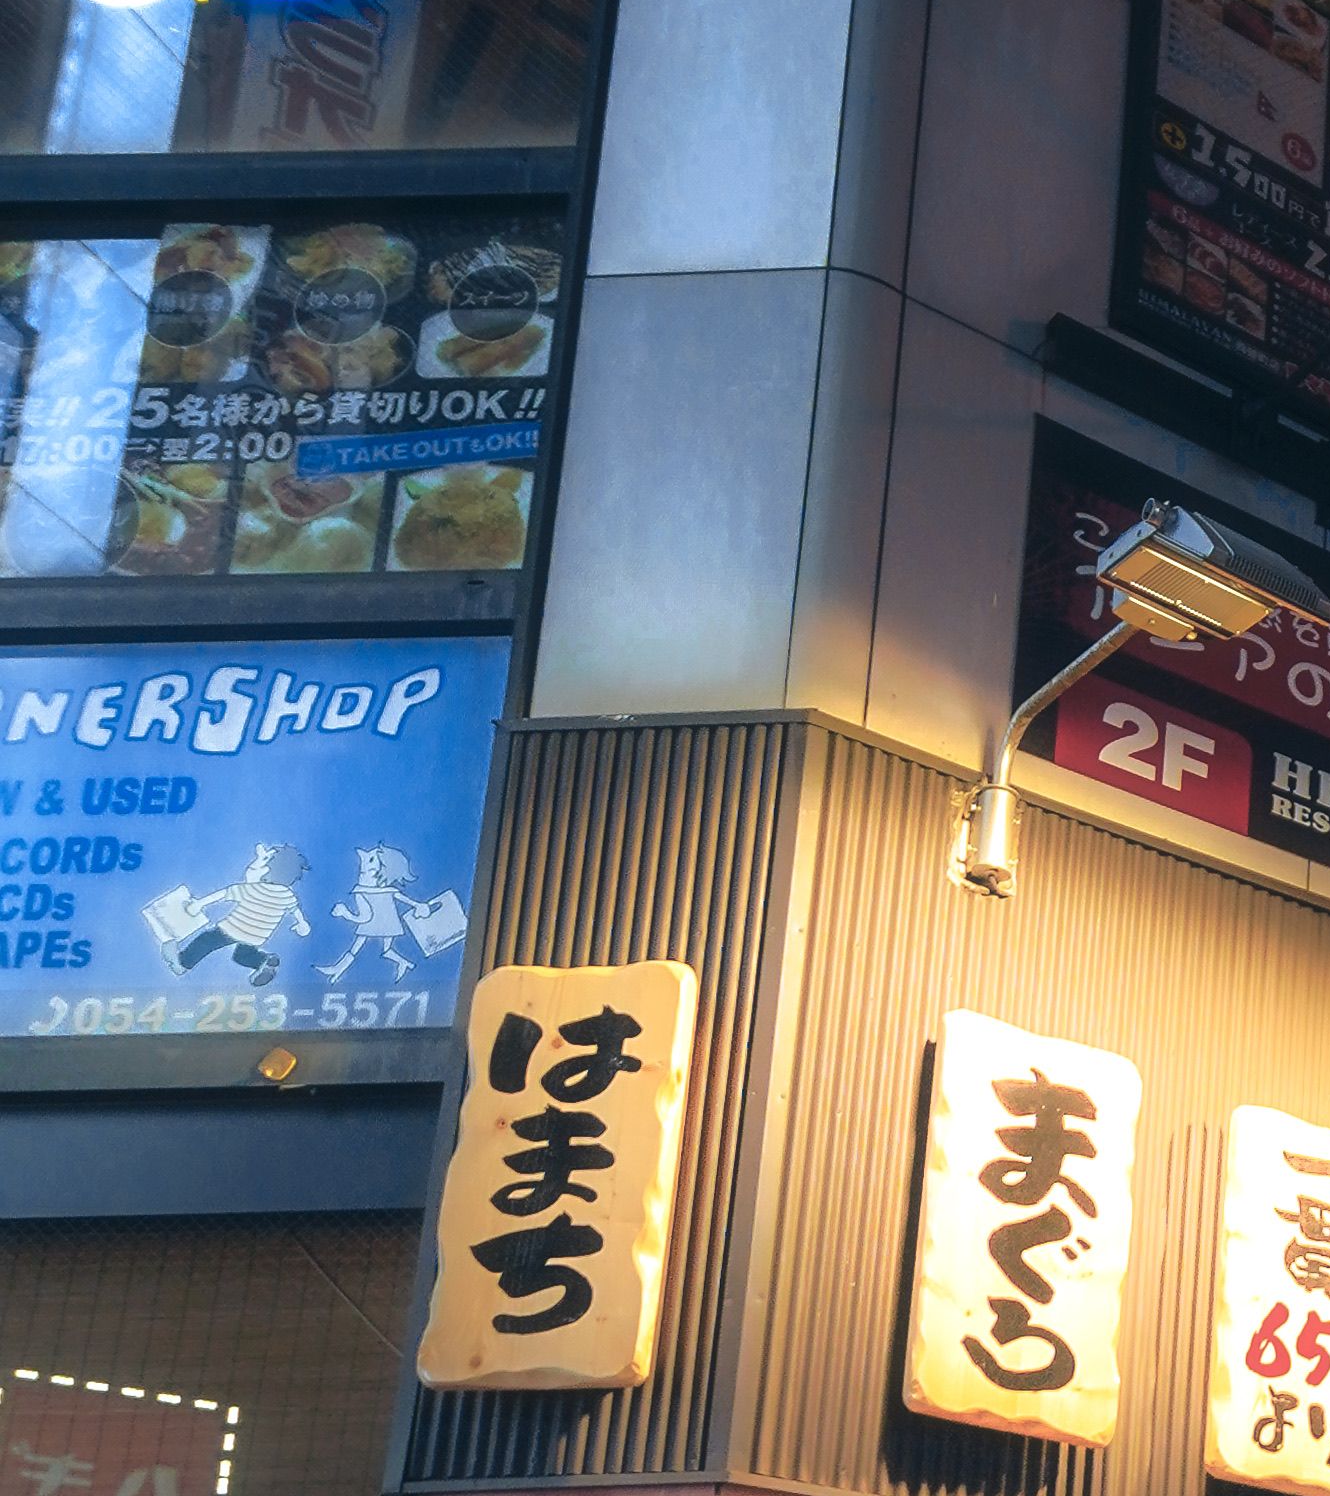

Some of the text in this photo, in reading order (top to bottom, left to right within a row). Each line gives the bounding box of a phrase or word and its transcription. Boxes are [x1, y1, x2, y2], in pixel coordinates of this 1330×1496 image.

[337, 442, 408, 467] TAKE
[0, 663, 443, 755] NERSHOP
[1097, 701, 1216, 793] 2F
[80, 776, 198, 817] USED
[70, 990, 432, 1033] 054-253-5571
[469, 1003, 644, 1336] はまち
[961, 1067, 1100, 1393] まぐろ
